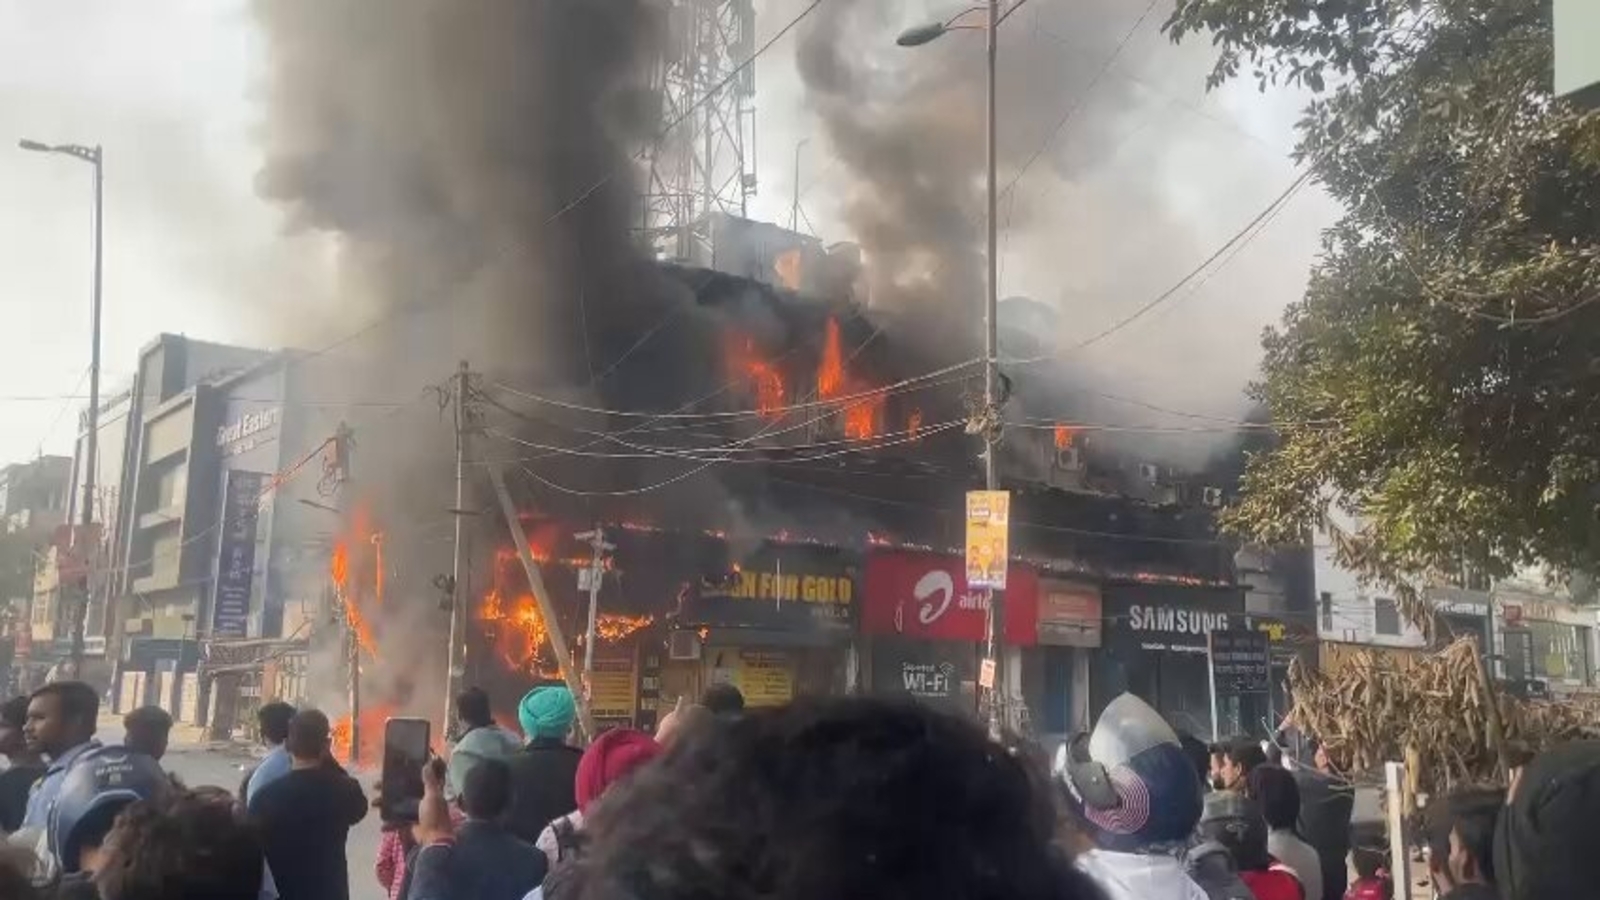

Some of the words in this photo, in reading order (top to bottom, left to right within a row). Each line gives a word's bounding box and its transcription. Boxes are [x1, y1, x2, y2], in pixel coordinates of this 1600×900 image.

[760, 571, 799, 602] FOR
[801, 574, 852, 604] GOLD
[1129, 603, 1229, 634] SAMSUNG
